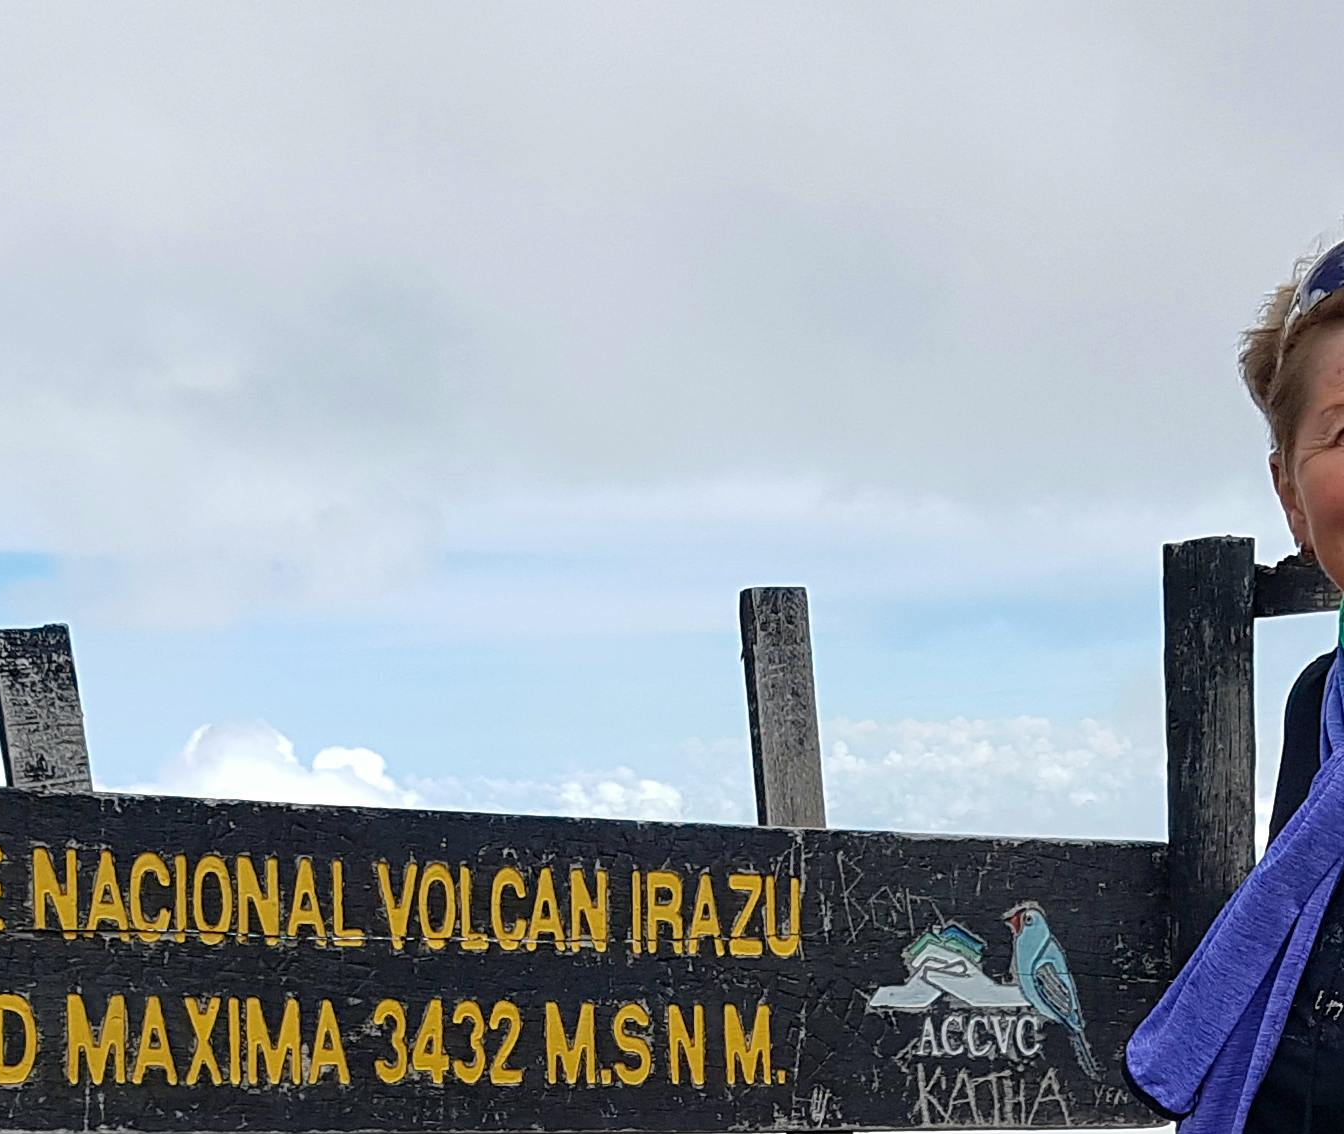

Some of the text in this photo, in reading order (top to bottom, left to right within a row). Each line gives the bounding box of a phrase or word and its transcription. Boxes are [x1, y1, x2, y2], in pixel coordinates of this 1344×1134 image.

[32, 847, 366, 947] NACIONAL
[375, 861, 610, 954] VOLCAN
[632, 869, 802, 957] IRAZU
[66, 993, 352, 1086] MAXIMA
[373, 998, 524, 1085] 3432
[915, 1015, 1042, 1057] ACCVC
